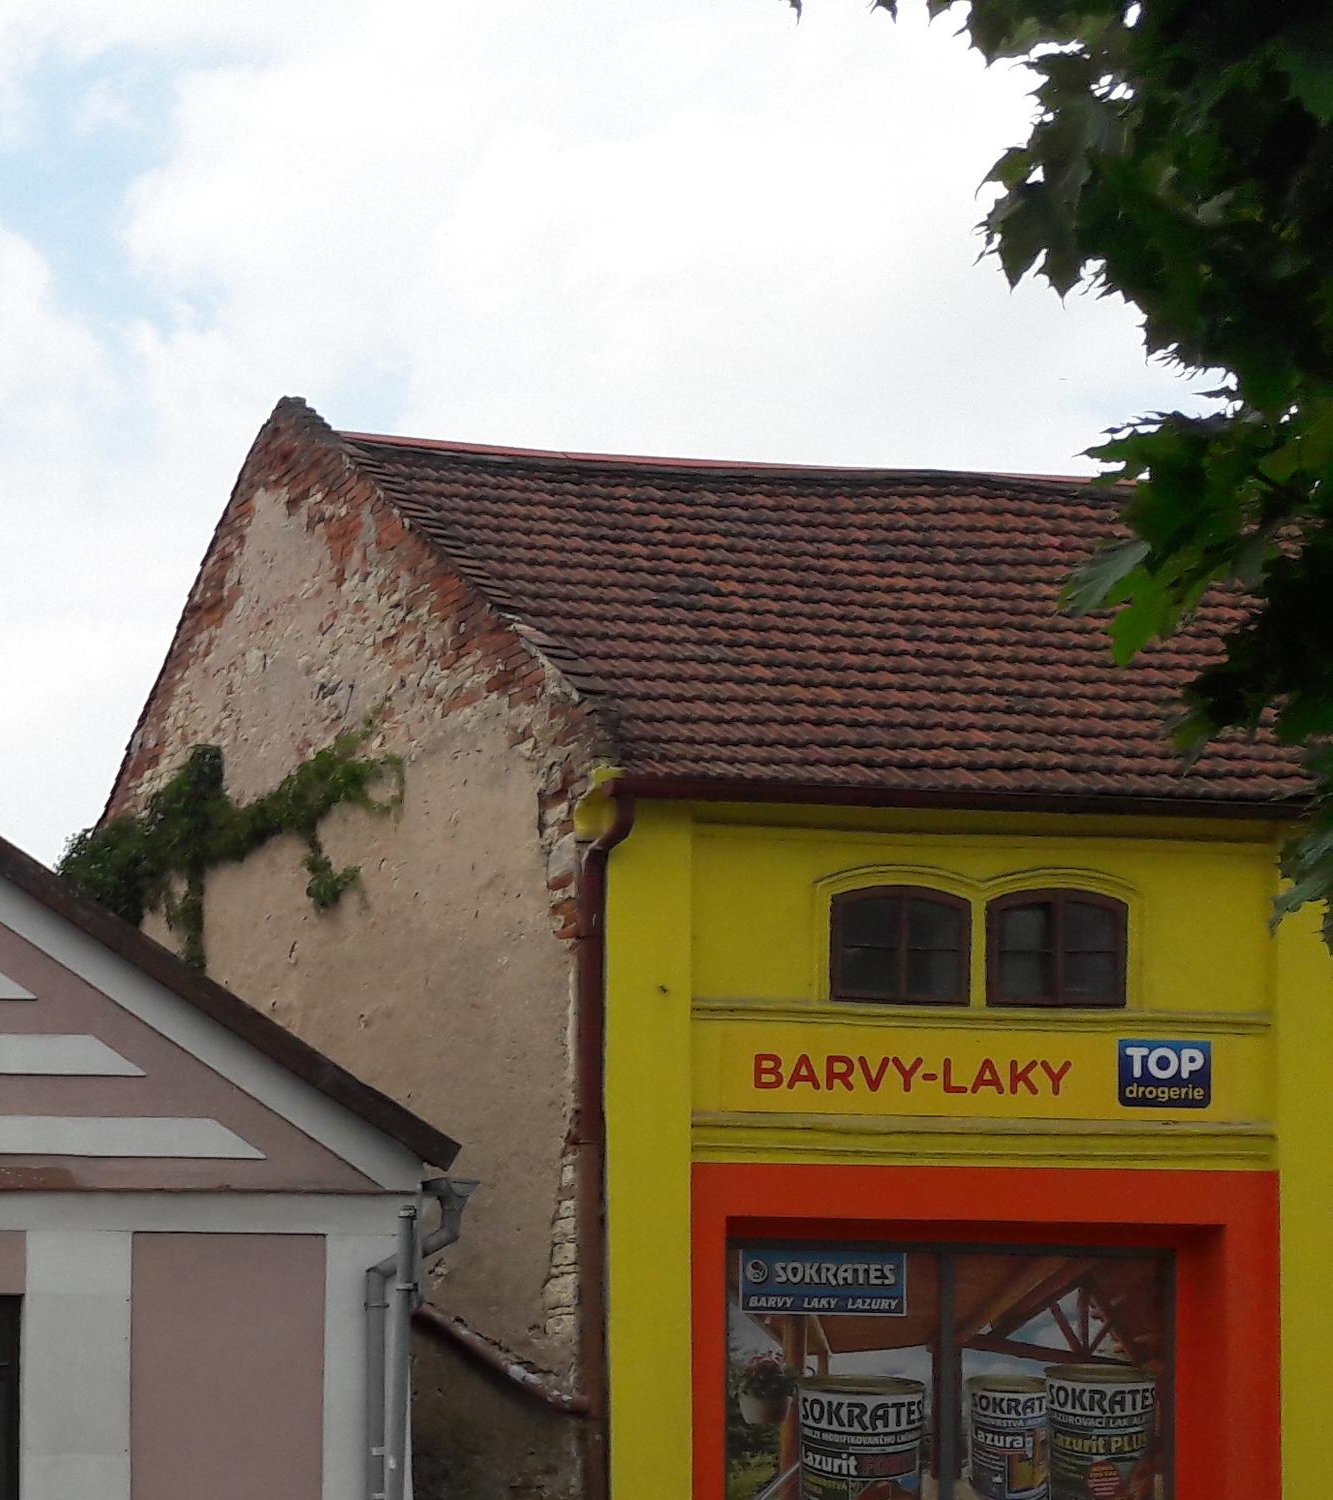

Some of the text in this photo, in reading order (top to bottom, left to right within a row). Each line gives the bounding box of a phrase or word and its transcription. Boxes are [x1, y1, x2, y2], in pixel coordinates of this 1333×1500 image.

[753, 1053, 1072, 1096] BARVY-LAKY
[1125, 1047, 1205, 1080] TOP
[1124, 1083, 1205, 1102] drogerie
[774, 1261, 896, 1286] SOKRATES
[748, 1296, 899, 1310] BARVY LAKY LAZURY
[802, 1396, 924, 1431] SOKRATES
[973, 1393, 1046, 1416] SOKRAT
[1048, 1384, 1156, 1416] SOKRATES
